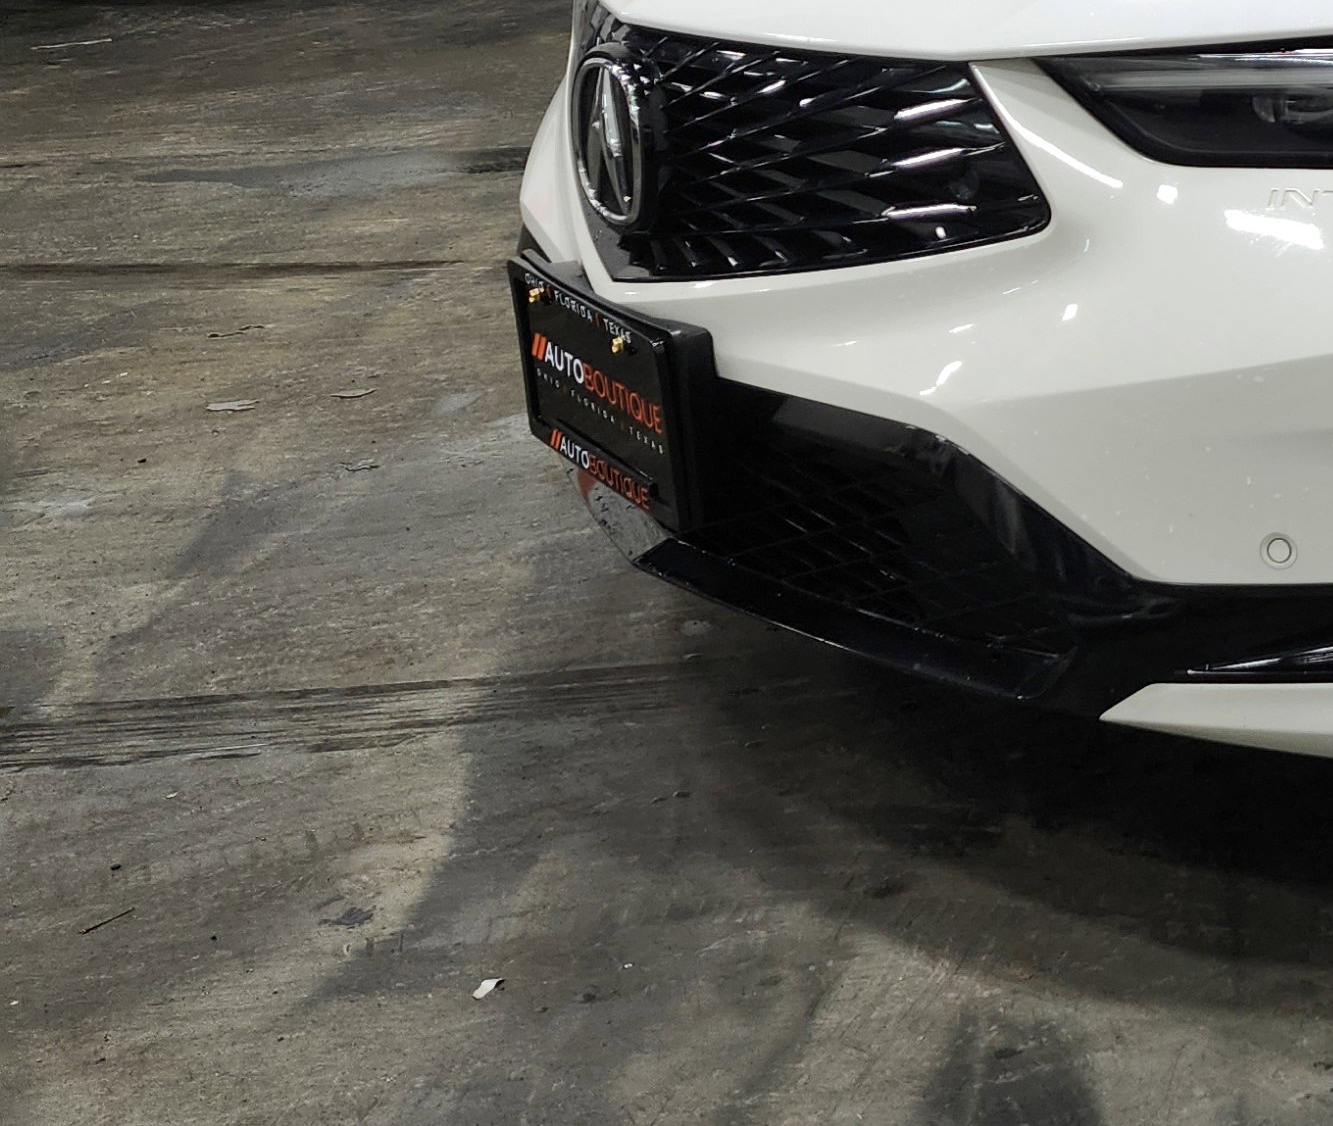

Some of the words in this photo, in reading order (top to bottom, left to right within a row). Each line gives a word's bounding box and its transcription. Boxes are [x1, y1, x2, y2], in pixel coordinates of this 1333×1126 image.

[553, 289, 593, 323] FLORIDA
[544, 340, 662, 435] AUTOBOUTIQUE
[559, 436, 651, 511] AUTOBOUTIQUE
